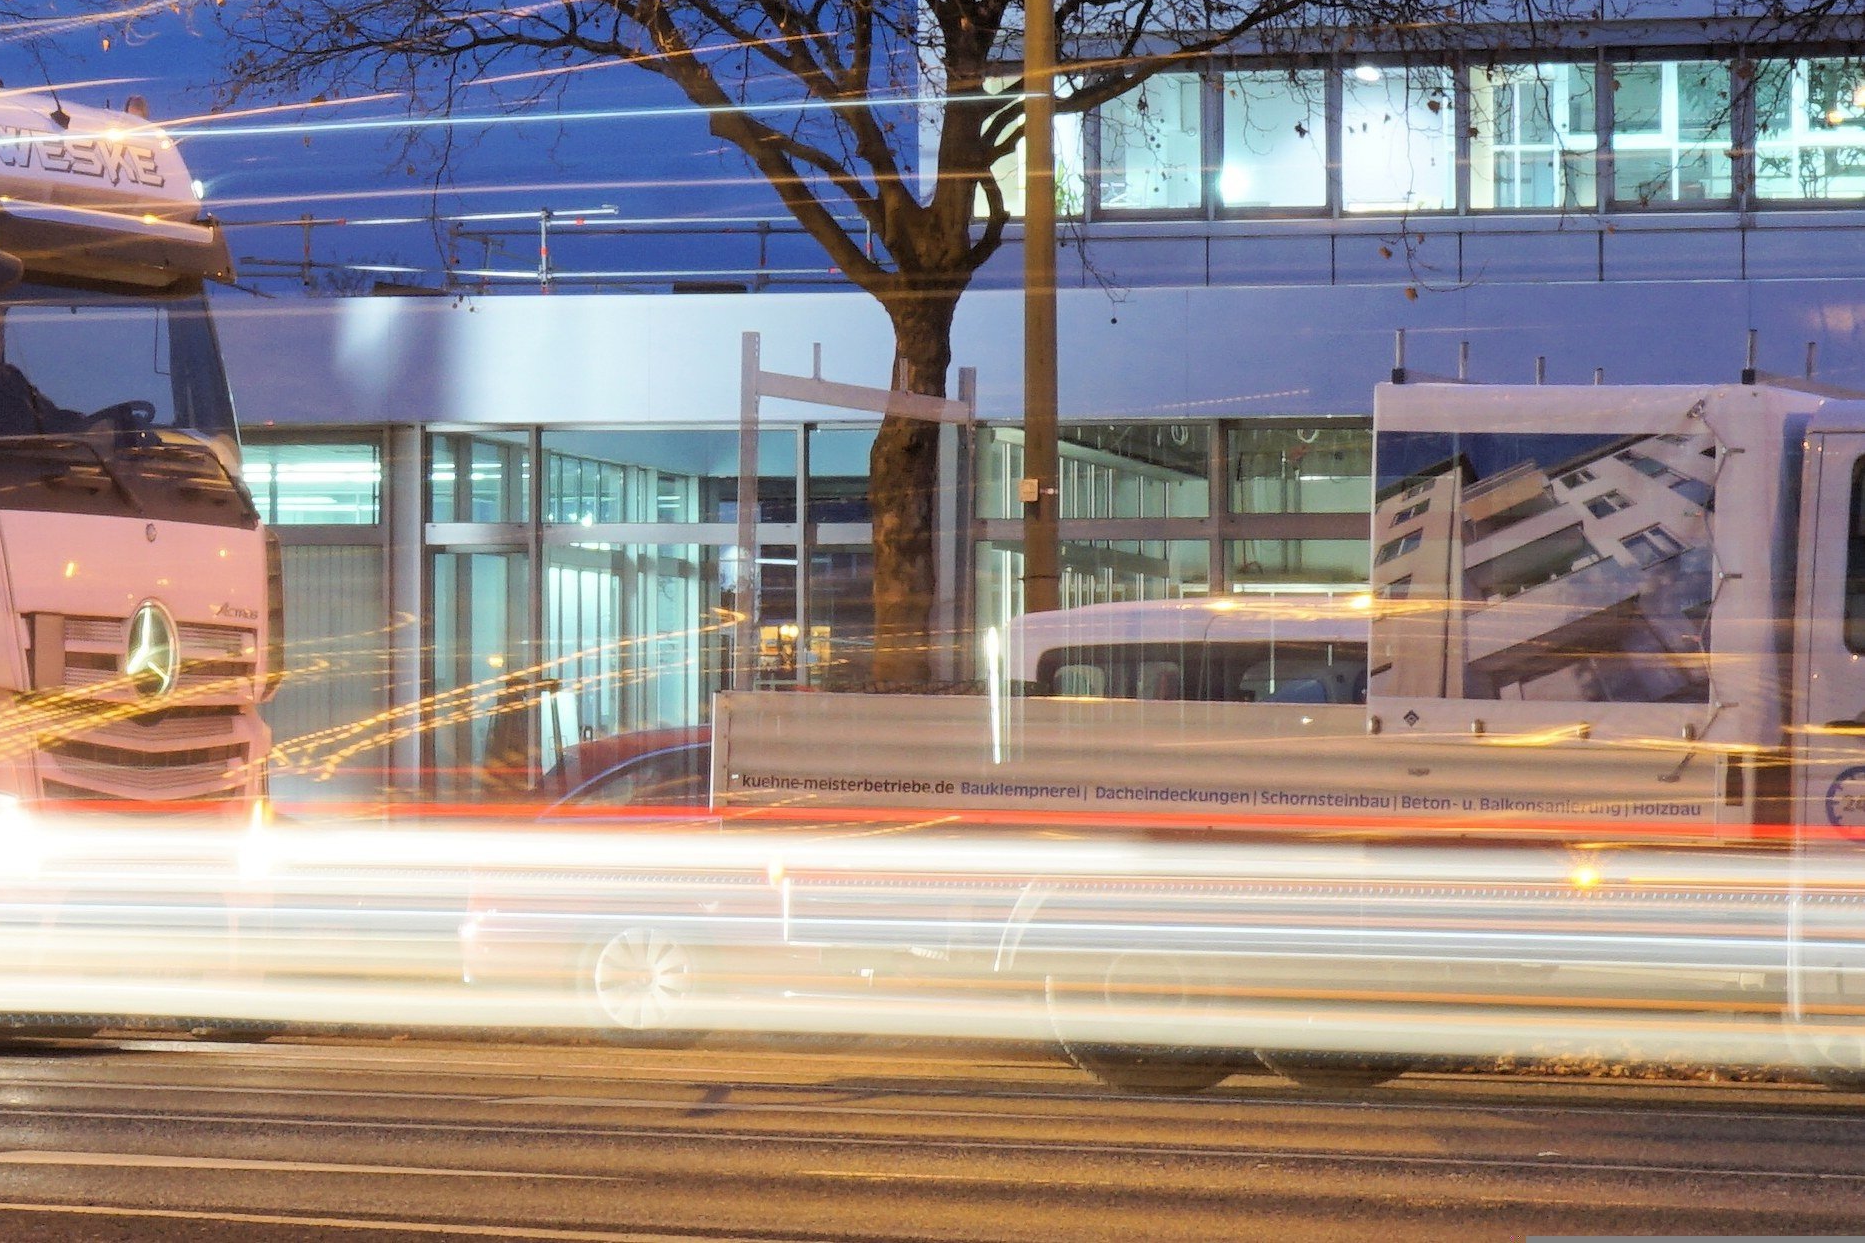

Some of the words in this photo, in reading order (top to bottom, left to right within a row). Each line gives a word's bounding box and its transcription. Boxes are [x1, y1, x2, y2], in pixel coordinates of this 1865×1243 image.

[741, 773, 956, 796] kuehne-meisterbetriebe.de
[1095, 785, 1251, 805] Dacheindeckungen
[1261, 790, 1391, 810] Schornsteinbau
